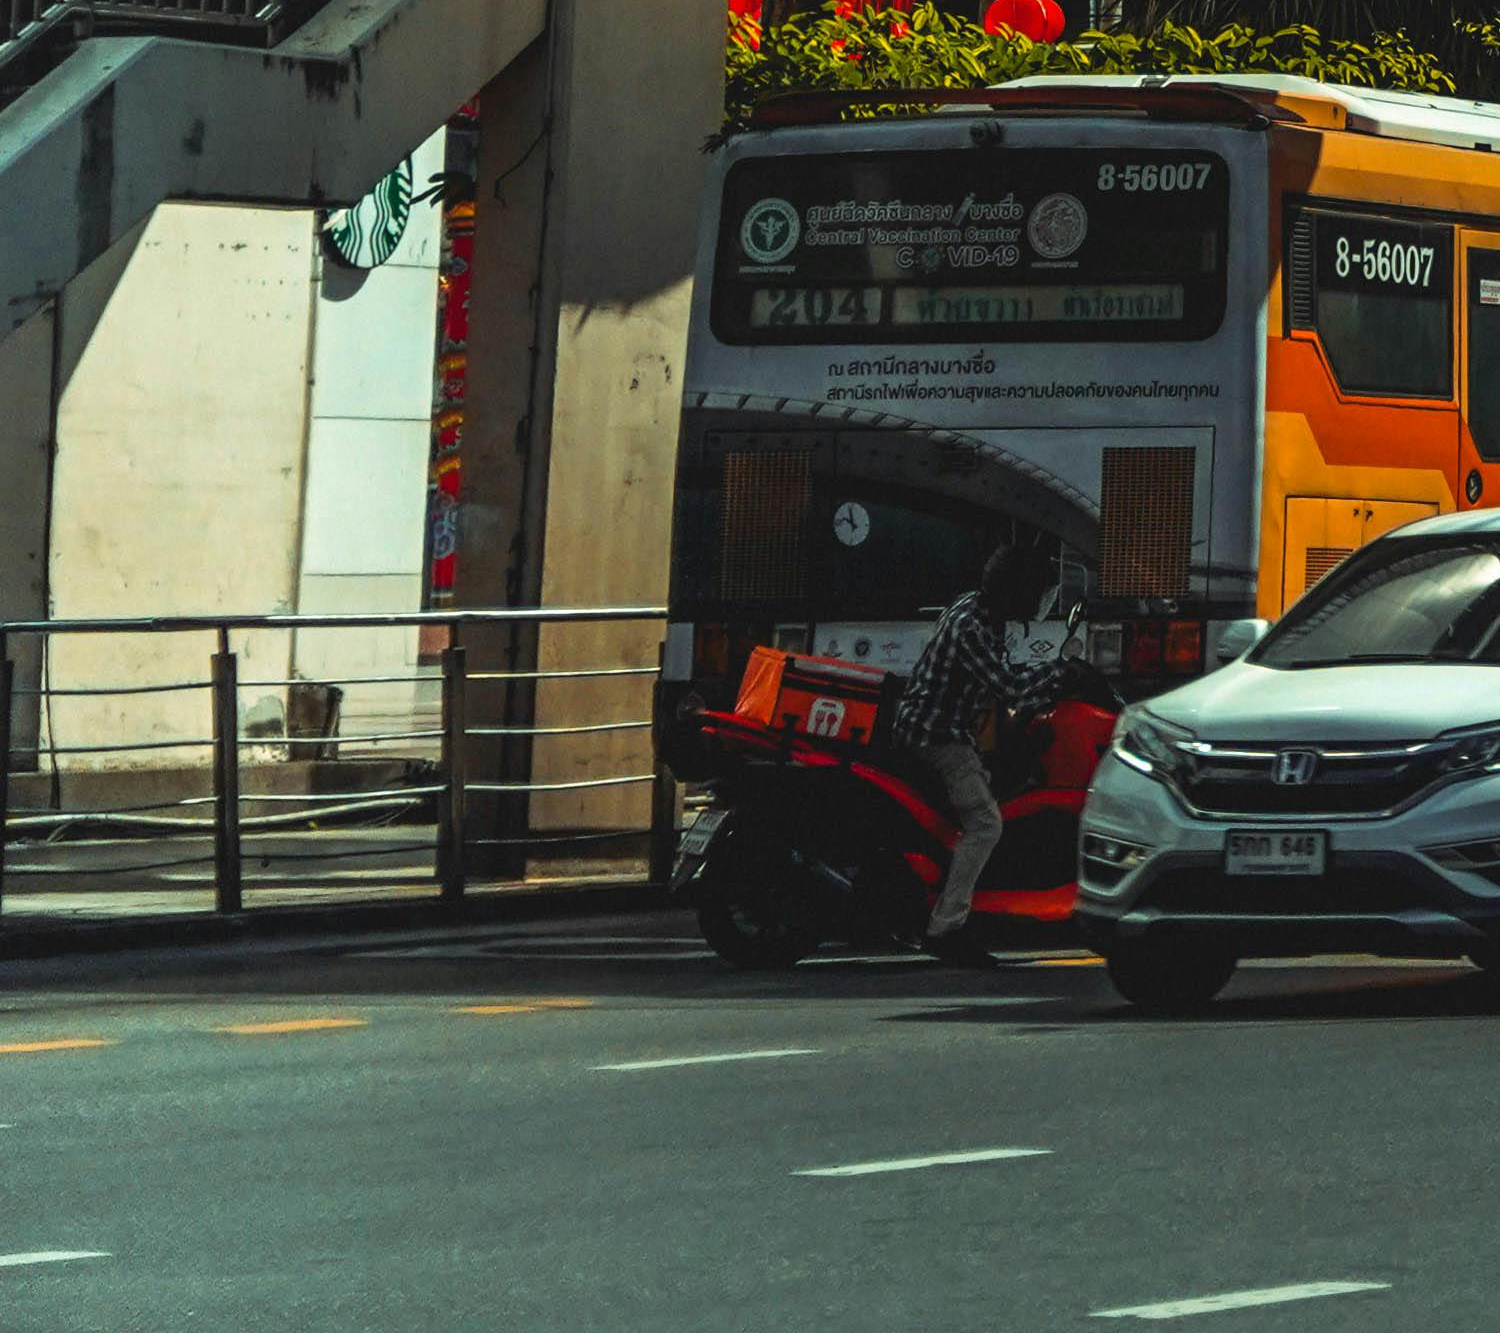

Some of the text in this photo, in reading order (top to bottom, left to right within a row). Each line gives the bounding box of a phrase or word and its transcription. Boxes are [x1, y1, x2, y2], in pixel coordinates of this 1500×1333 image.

[1097, 162, 1212, 192] 8-56007
[805, 192, 1024, 230] ศูนย์ฉีดวัคซีนกลาง บางซื่อ
[804, 226, 1021, 246] Central Vaccination Center
[1335, 236, 1435, 288] 8-56007
[768, 285, 868, 325] 204
[828, 349, 996, 377] ณ สถานีกลางบางซื่อ
[826, 380, 1220, 404] สถานีรถไฟเพื่อความสุขและความปลอดภัยของคนไทยทุกคน
